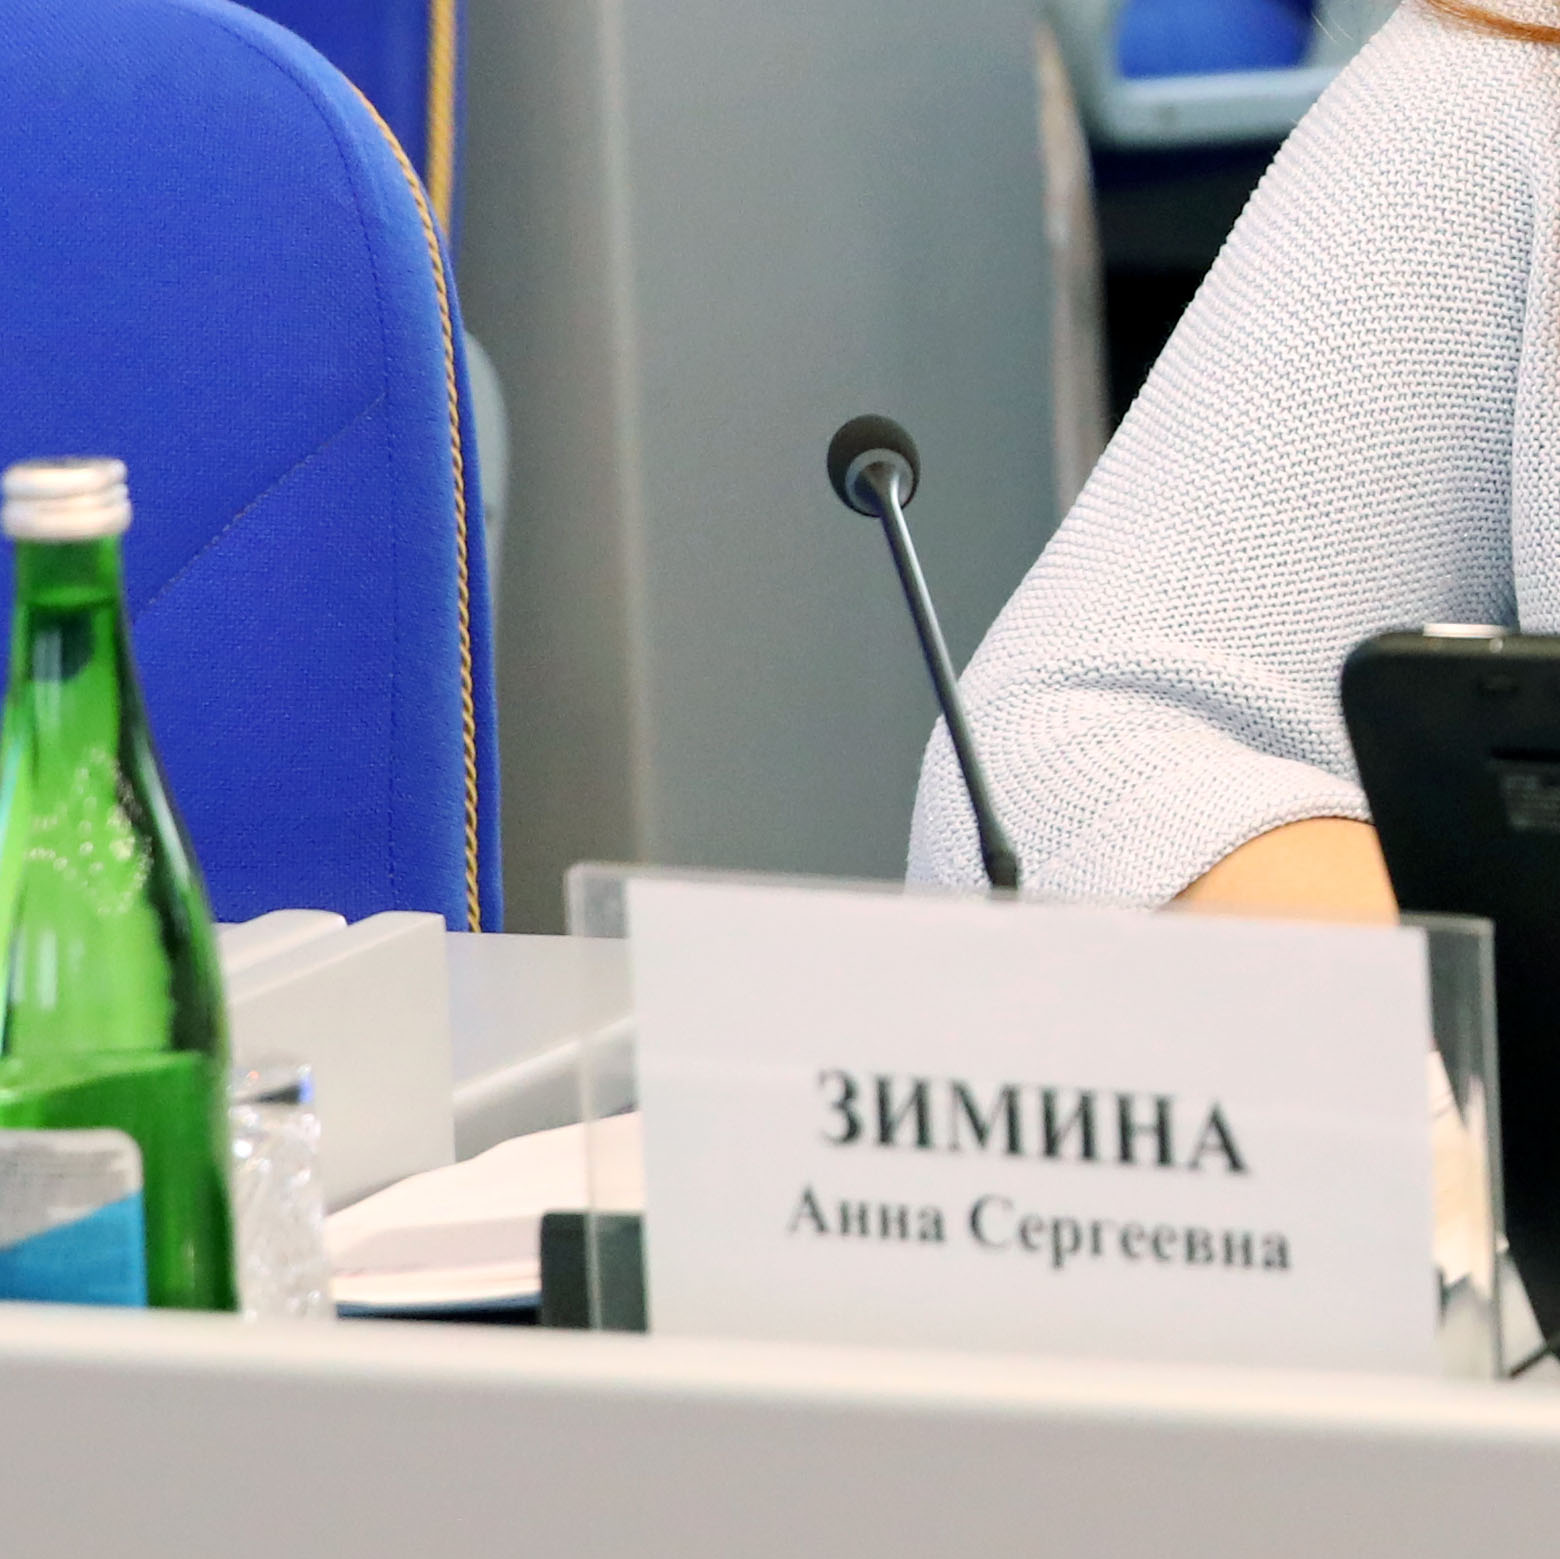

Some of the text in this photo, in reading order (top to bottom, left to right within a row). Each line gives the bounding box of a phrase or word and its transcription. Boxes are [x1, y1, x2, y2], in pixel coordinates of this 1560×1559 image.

[818, 1070, 1249, 1176] ЗИМИНА
[790, 1187, 1291, 1272] Анна Сергеевна
